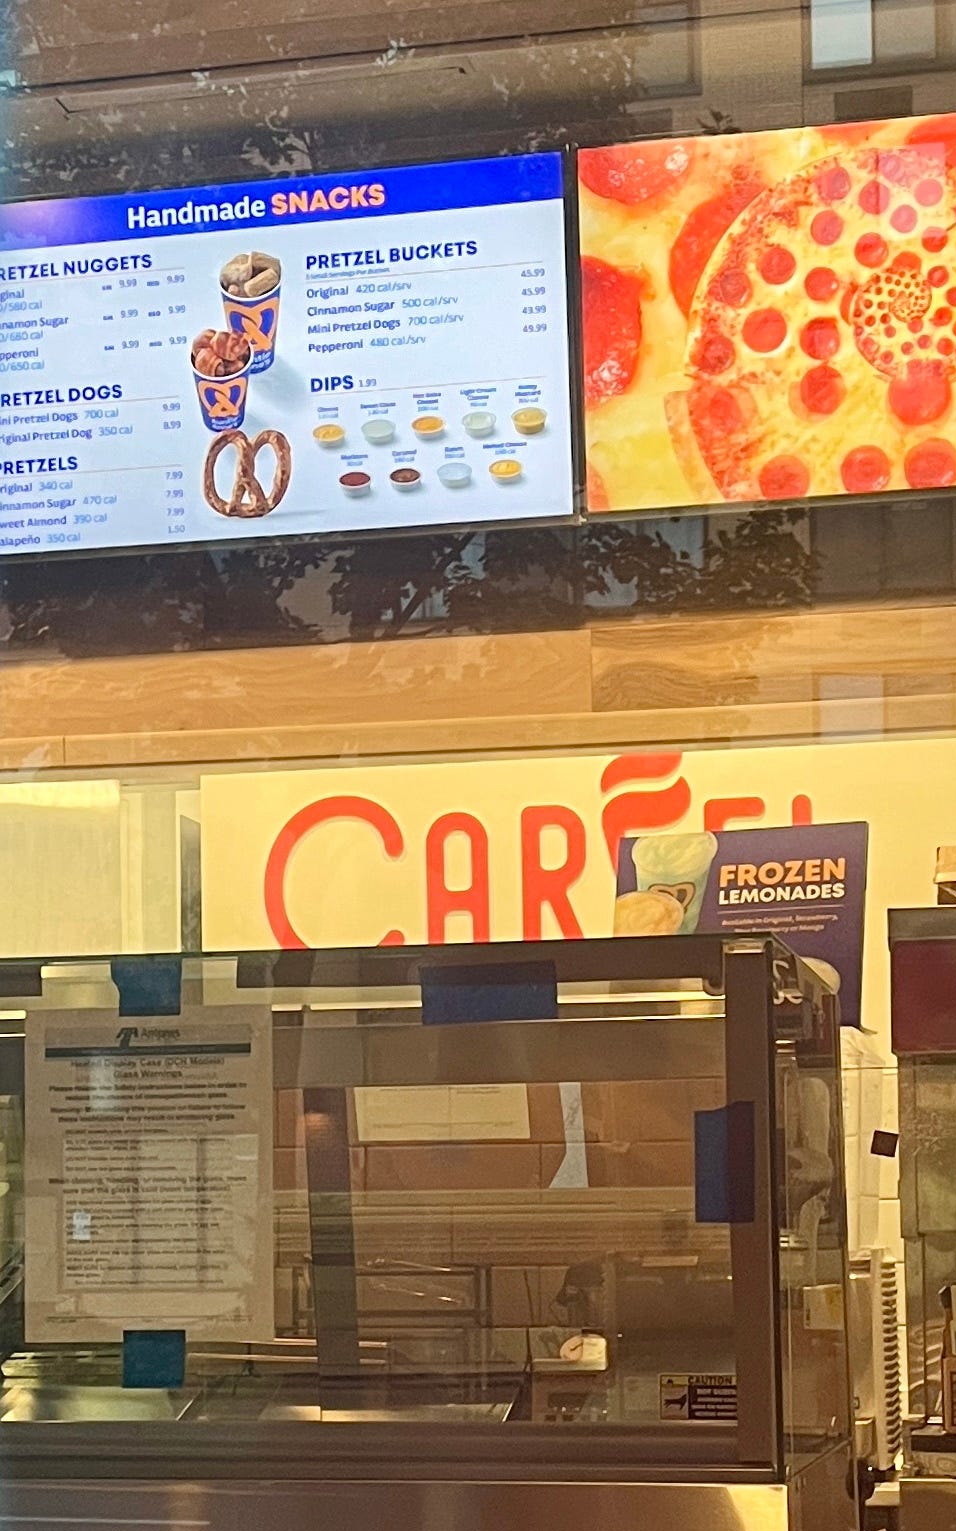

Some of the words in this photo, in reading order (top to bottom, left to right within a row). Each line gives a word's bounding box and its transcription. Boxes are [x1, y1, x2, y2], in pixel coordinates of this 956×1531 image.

[127, 196, 266, 229] Handmade
[271, 184, 385, 215] SNACKS
[306, 249, 385, 270] PRETZEL
[389, 240, 478, 263] BUCKETS
[0, 262, 59, 281] RETZEL
[63, 253, 153, 276] NUGGETS
[306, 285, 349, 299] Original
[307, 304, 362, 317] Cinnamon
[364, 301, 395, 313] Sugar
[40, 316, 69, 328] Sugar
[307, 322, 331, 334] Mini
[332, 320, 371, 333] Pretzel
[373, 318, 401, 331] Dogs
[308, 339, 364, 354] Pepperoni
[310, 375, 354, 393] DIPS
[0, 389, 64, 407] RETZEL
[68, 384, 123, 402] DOGS
[13, 413, 49, 424] Pretzel
[52, 412, 78, 423] Dogs
[105, 408, 119, 418] cal
[33, 429, 69, 441] Pretzel
[71, 429, 92, 440] Dog
[119, 425, 133, 435] cal
[0, 456, 78, 475] RETZELS
[59, 480, 73, 490] cal
[46, 498, 77, 509] Sugar
[103, 495, 117, 504] cal
[0, 519, 24, 529] weet
[27, 515, 67, 527] Almond
[93, 513, 107, 523] cal
[0, 534, 41, 547] alapeño
[66, 533, 80, 542] cal
[719, 857, 846, 888] FROZEN
[718, 882, 845, 905] LEMONADES
